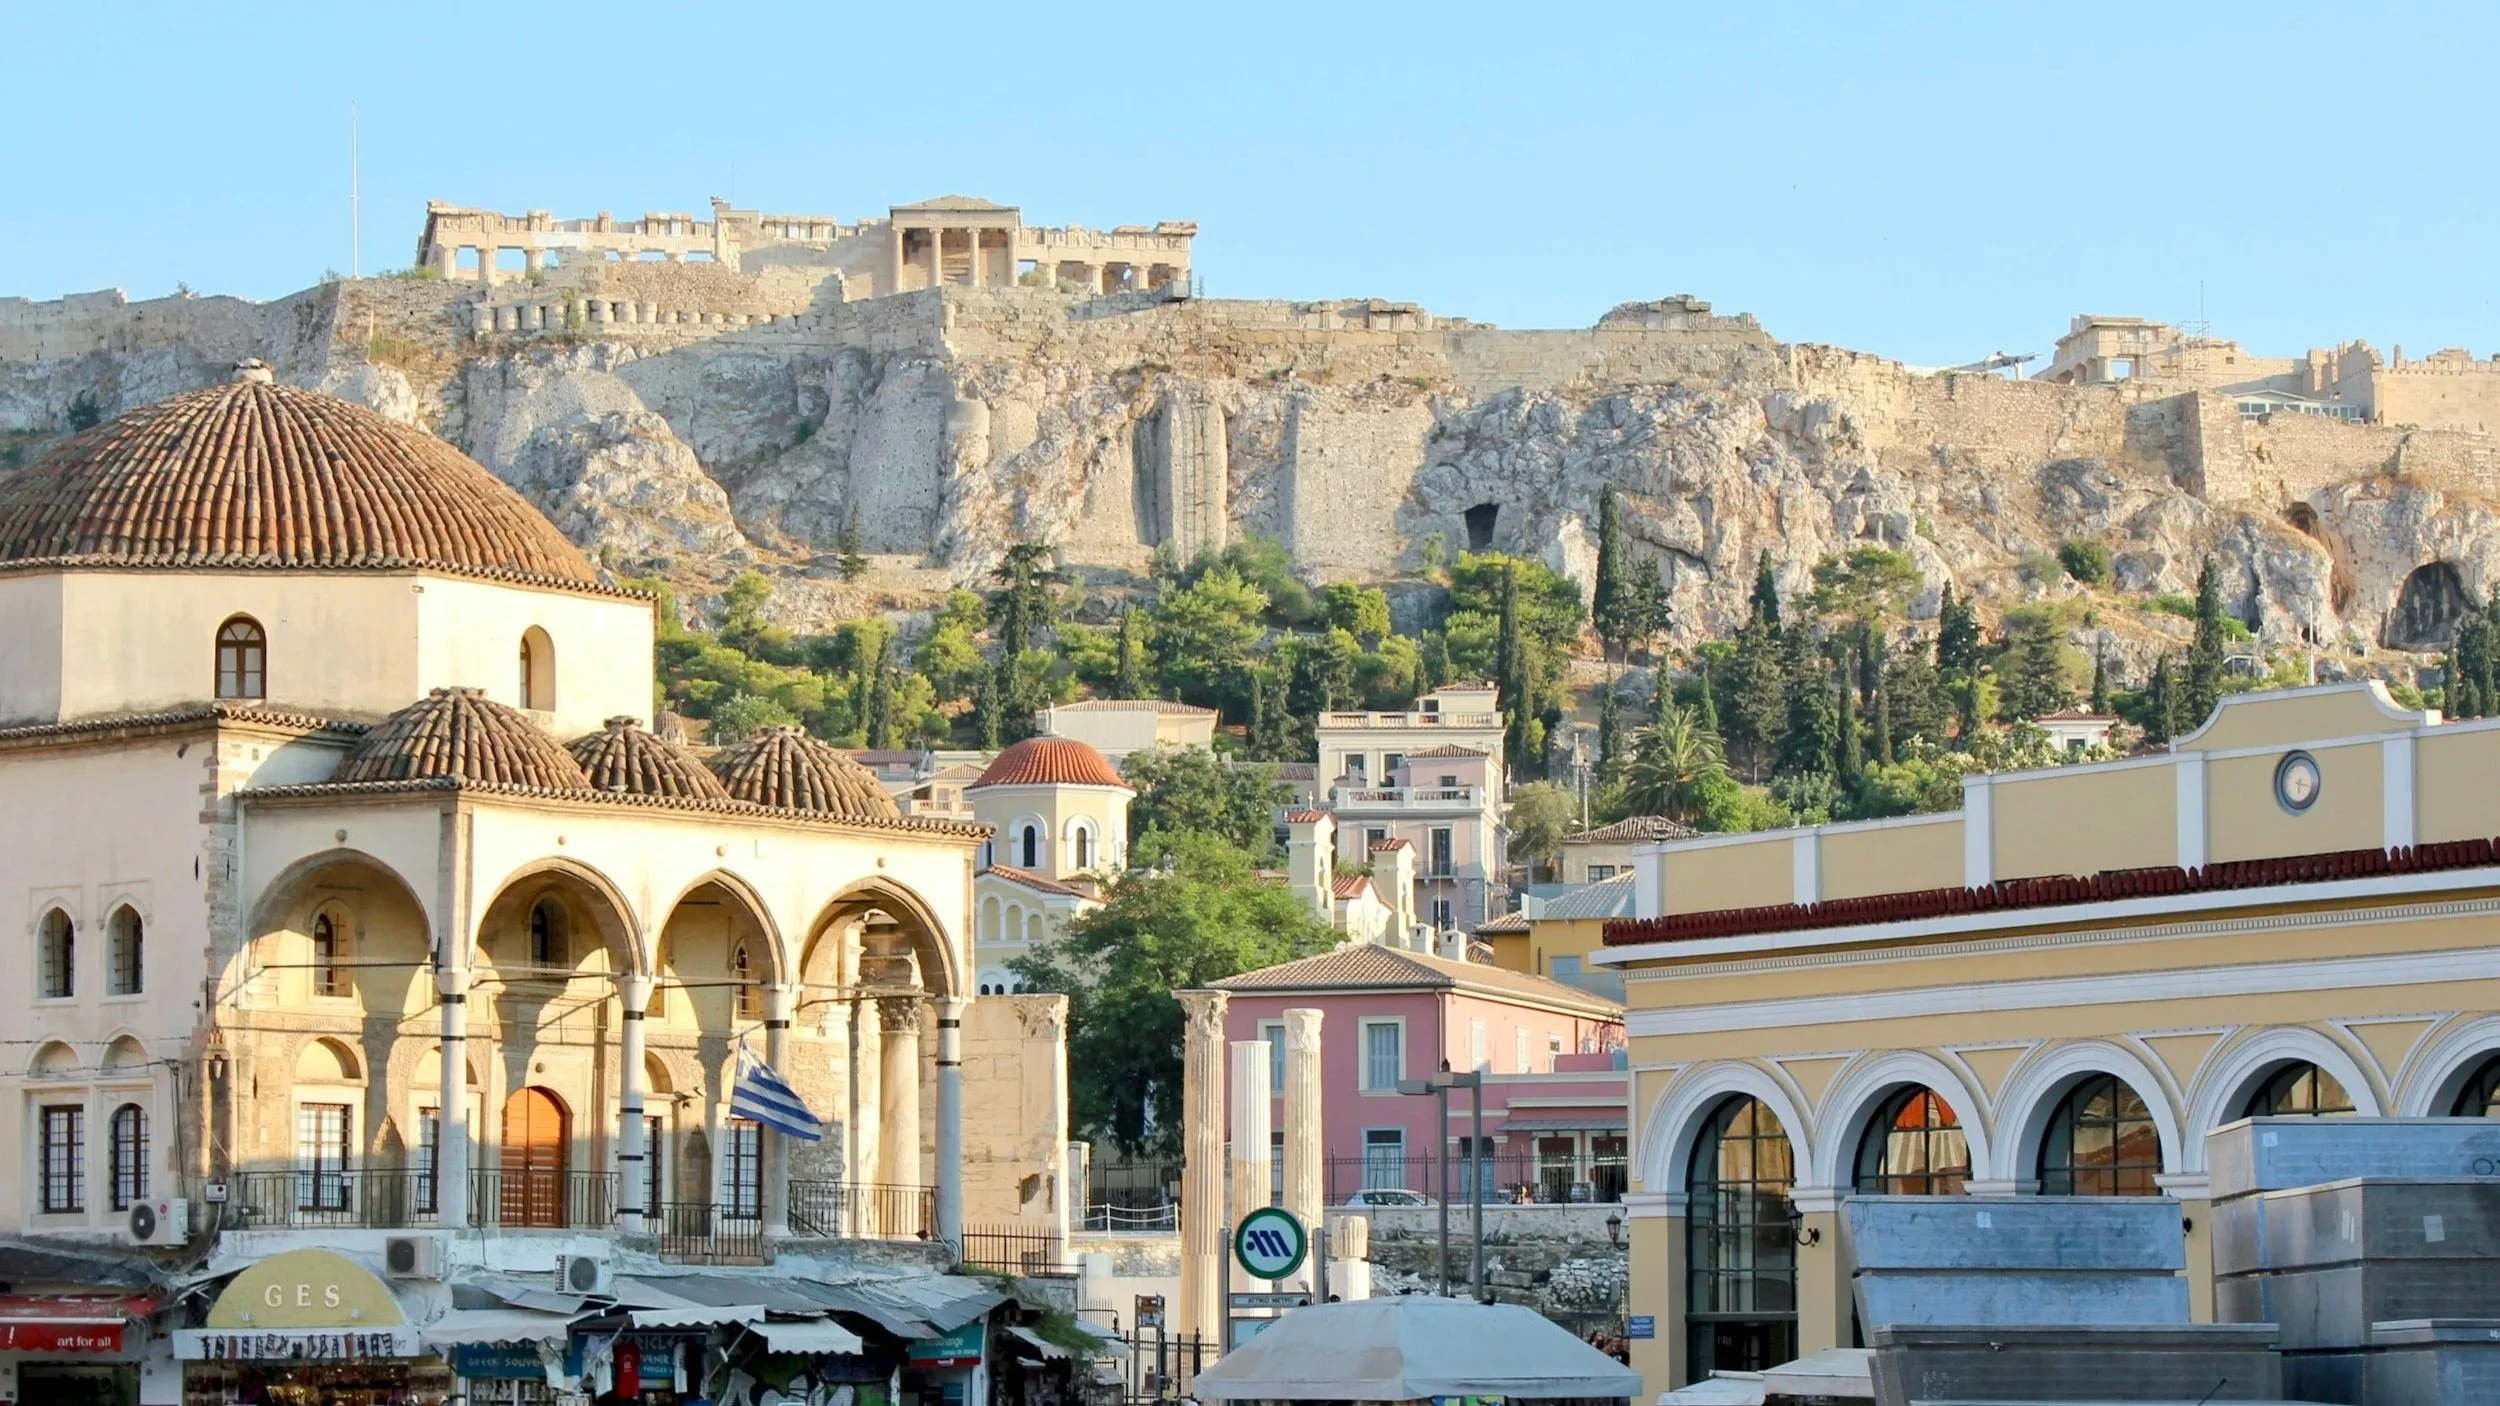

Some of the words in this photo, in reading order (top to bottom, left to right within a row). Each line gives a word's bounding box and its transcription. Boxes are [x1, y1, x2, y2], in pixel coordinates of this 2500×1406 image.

[57, 1337, 73, 1347] art
[77, 1336, 94, 1347] for
[97, 1337, 111, 1347] all
